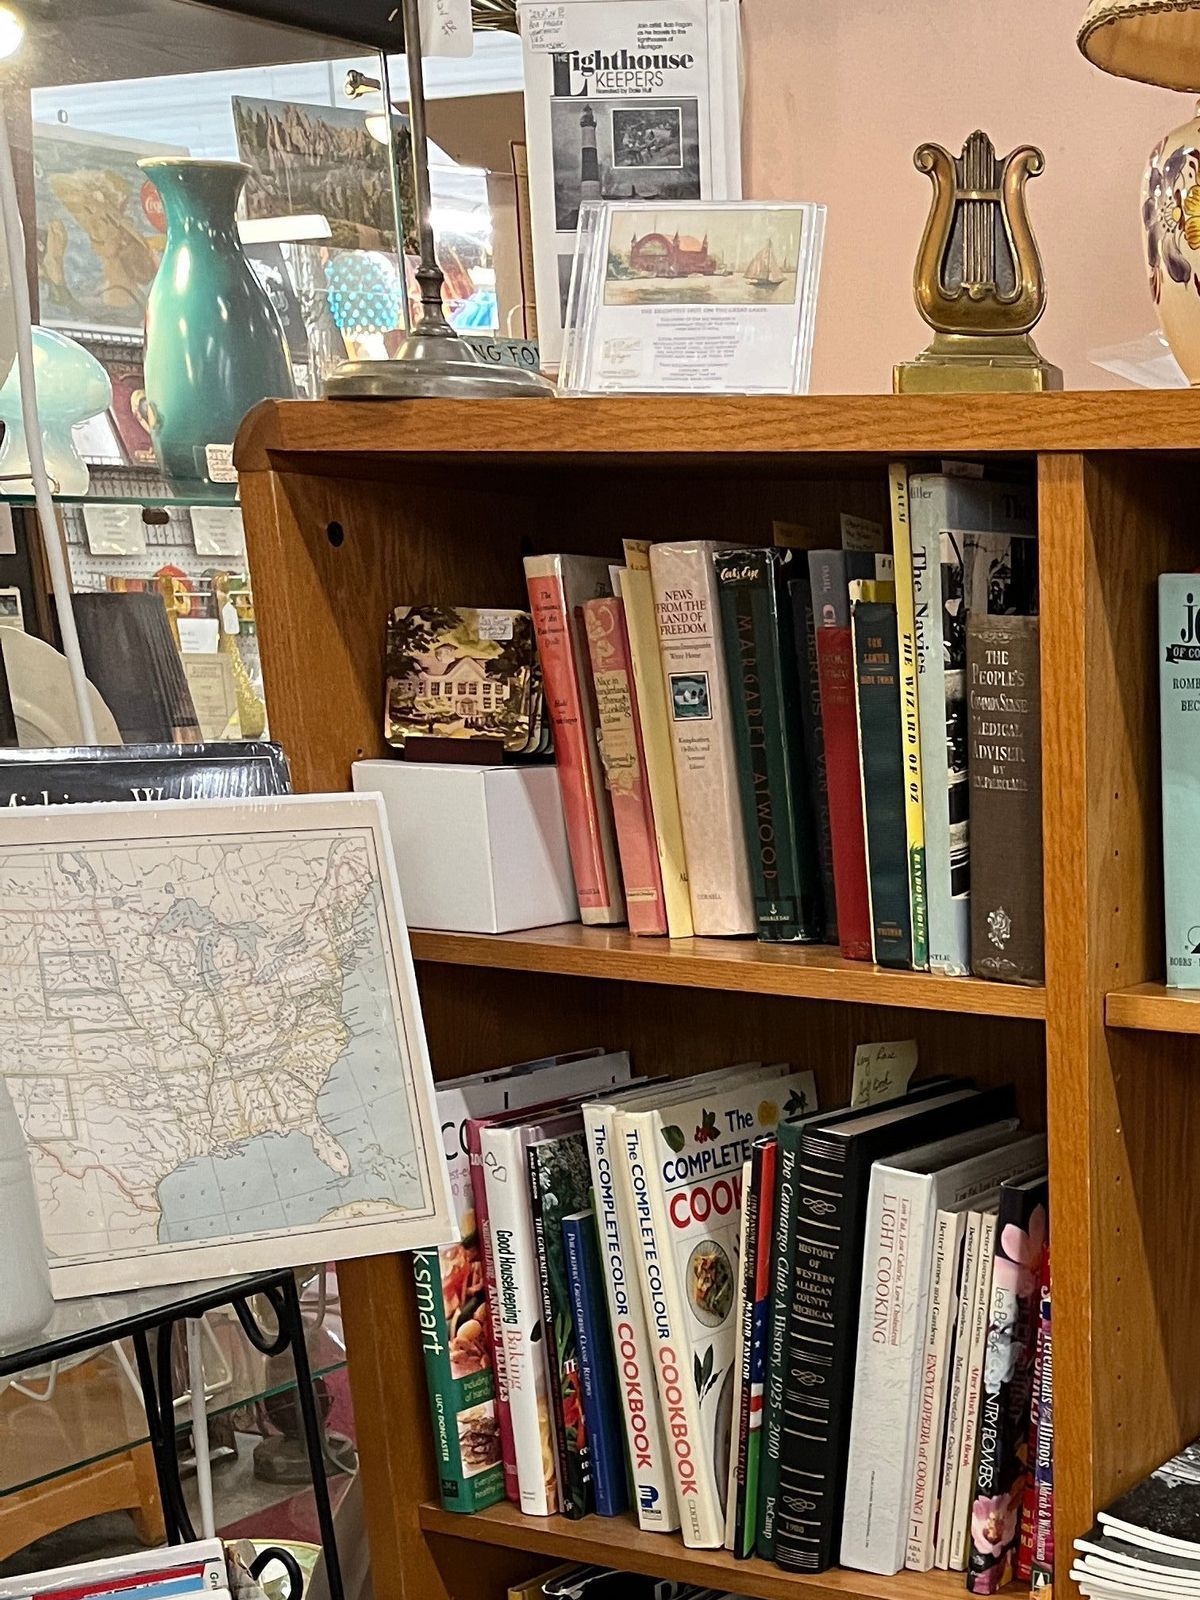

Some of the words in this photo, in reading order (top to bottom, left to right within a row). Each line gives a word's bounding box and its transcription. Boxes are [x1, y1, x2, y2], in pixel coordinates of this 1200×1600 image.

[548, 49, 694, 97] Lighthouse
[595, 70, 664, 88] KEEPERS
[912, 545, 927, 594] The
[655, 601, 685, 615] FROM
[684, 600, 707, 611] THE
[665, 589, 694, 601] NEWS
[660, 612, 689, 625] LAND
[689, 611, 704, 623] OF
[660, 622, 708, 636] FREEDOM
[903, 633, 913, 667] THE
[914, 602, 930, 675] Navies
[1172, 646, 1188, 658] OF
[972, 662, 1025, 688] PEOPLE'S
[985, 650, 1010, 666] THE
[736, 614, 766, 751] MARGARET
[905, 676, 917, 744] WIZARD
[908, 753, 918, 776] OF
[910, 782, 920, 804] OZ
[752, 771, 777, 880] ATWOOD
[724, 1108, 754, 1132] The
[594, 1124, 606, 1156] The
[626, 1129, 640, 1161] The
[662, 1141, 750, 1184] COMPLETE
[782, 1150, 796, 1178] The
[598, 1159, 620, 1252] COMPLETE
[632, 1164, 658, 1261] COMPLETE
[776, 1182, 794, 1253] Camargo
[879, 1193, 897, 1254] LIGHT
[496, 1230, 513, 1256] Good
[798, 1242, 836, 1260] HISTORY
[938, 1220, 948, 1244] Better
[499, 1255, 520, 1325] Housekeeping
[611, 1255, 628, 1315] COLOR
[775, 1257, 790, 1297] Club:
[795, 1266, 836, 1285] WESTERN
[795, 1280, 833, 1297] ALLEGAN
[648, 1264, 670, 1340] COLOUR
[796, 1292, 830, 1308] COUNTY
[872, 1256, 892, 1345] COOKING
[994, 1286, 1009, 1308] Lee
[742, 1302, 754, 1340] MAJOR
[930, 1306, 940, 1346] Gardens
[506, 1330, 526, 1391] Baking
[742, 1343, 752, 1380] TAYLOR
[435, 1393, 445, 1415] LUCY
[618, 1322, 653, 1470] COOKBOOK
[770, 1373, 784, 1411] 1925
[919, 1354, 937, 1444] ENCYCLOPEDIA
[438, 1415, 450, 1462] DONCASTER
[658, 1346, 699, 1497] COOKBOOK
[767, 1422, 782, 1460] 2000
[918, 1446, 926, 1456] of
[978, 1428, 999, 1489] FLOWERS
[1038, 1419, 1054, 1468] Illinois
[912, 1459, 928, 1520] COOKING
[1038, 1480, 1052, 1508] Aldrich
[764, 1496, 776, 1540] DeCamp
